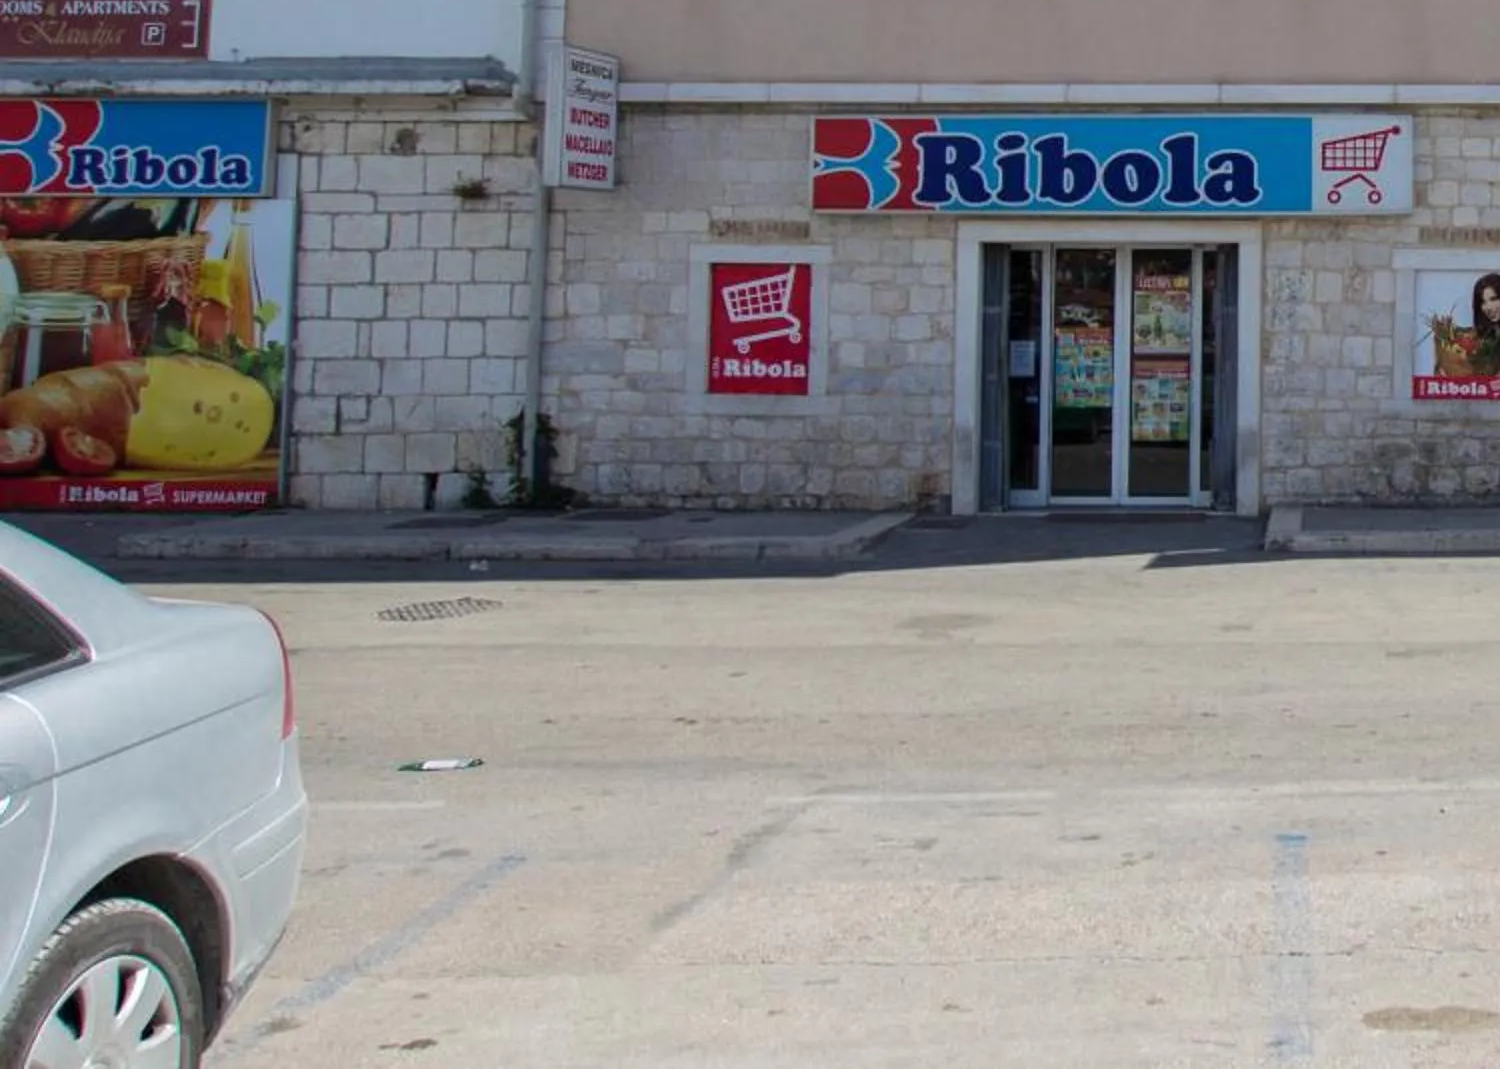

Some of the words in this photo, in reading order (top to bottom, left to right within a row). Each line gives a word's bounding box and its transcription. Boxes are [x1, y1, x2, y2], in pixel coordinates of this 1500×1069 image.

[61, 0, 170, 16] APARTMENTS
[570, 106, 610, 129] BUTCHER
[67, 146, 250, 187] Ribola
[567, 162, 608, 181] METZGER
[914, 133, 1262, 207] Ribola
[723, 358, 807, 377] Ribola
[1427, 380, 1488, 395] Ribola
[69, 485, 139, 502] Ribola
[172, 490, 267, 504] SUPERMARKET
